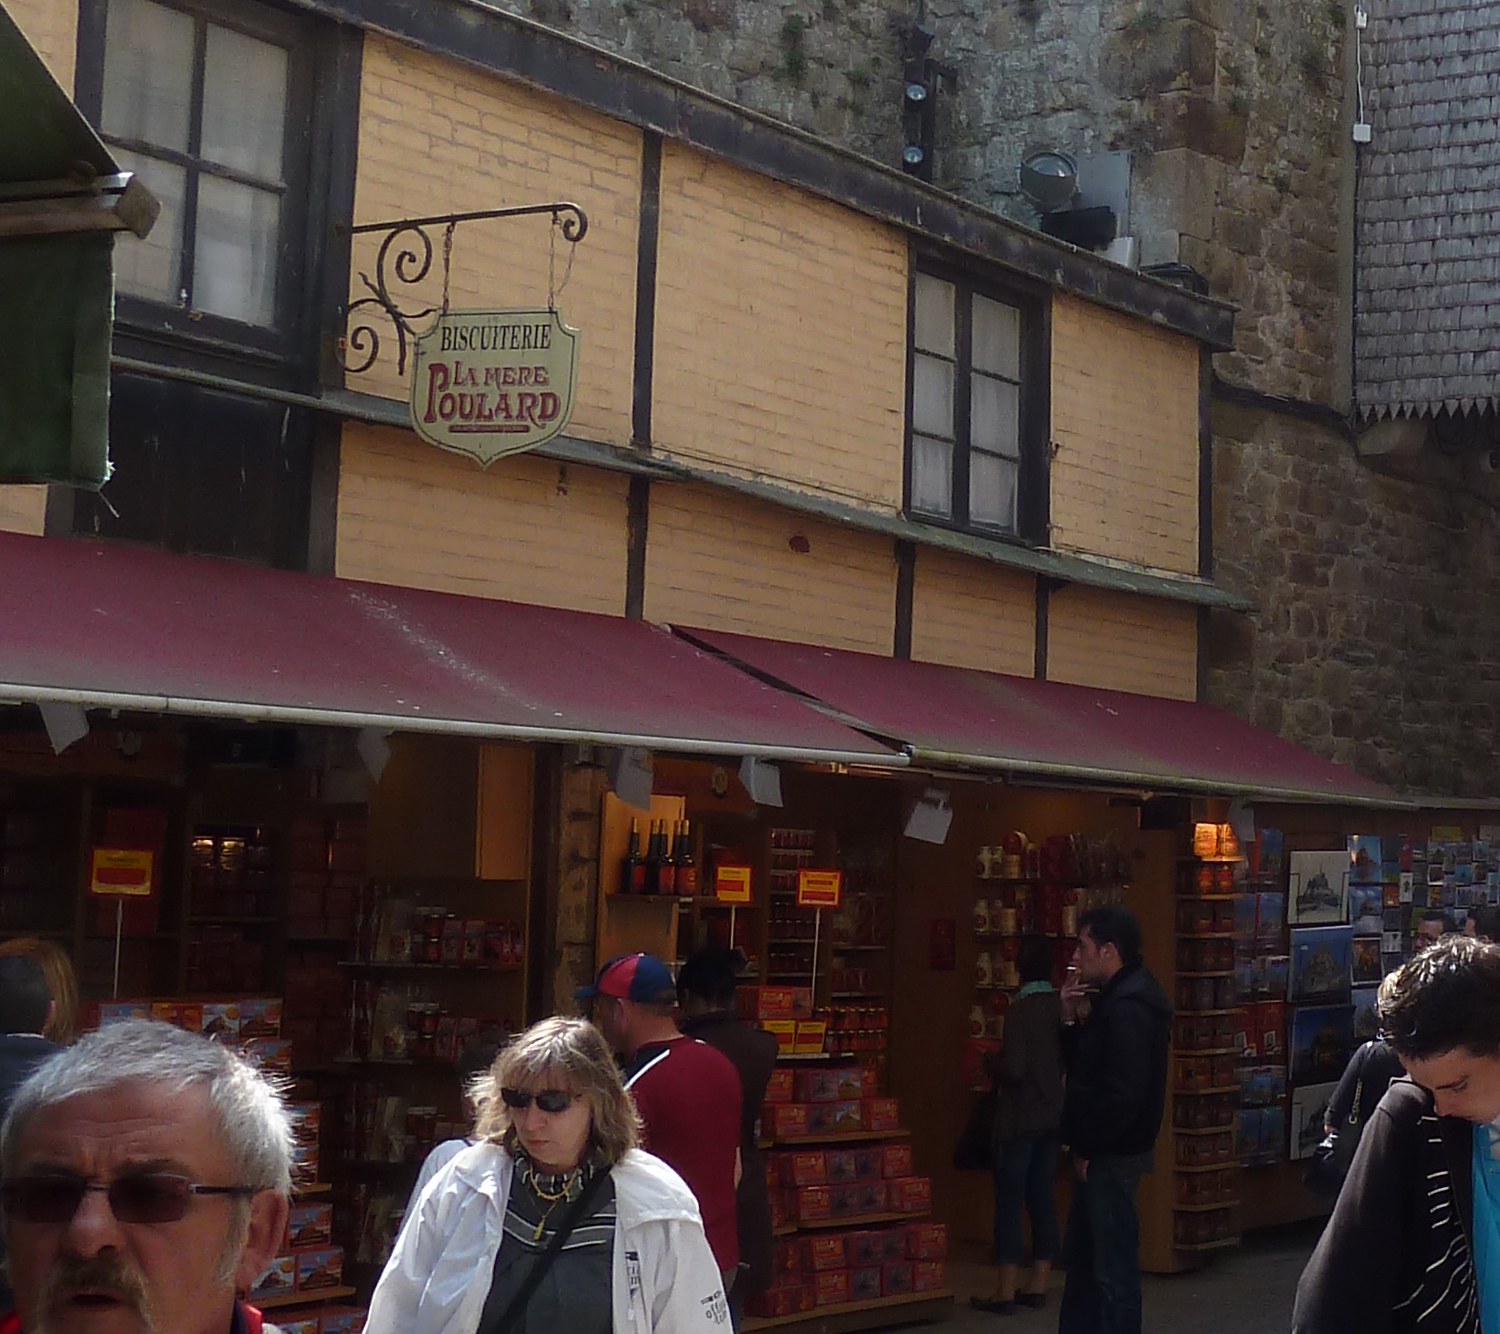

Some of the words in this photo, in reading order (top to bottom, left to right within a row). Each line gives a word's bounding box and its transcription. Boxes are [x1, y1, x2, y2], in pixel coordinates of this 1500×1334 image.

[441, 324, 552, 352] BISCUITERIE
[484, 366, 550, 390] MERE
[424, 363, 561, 430] POULARD
